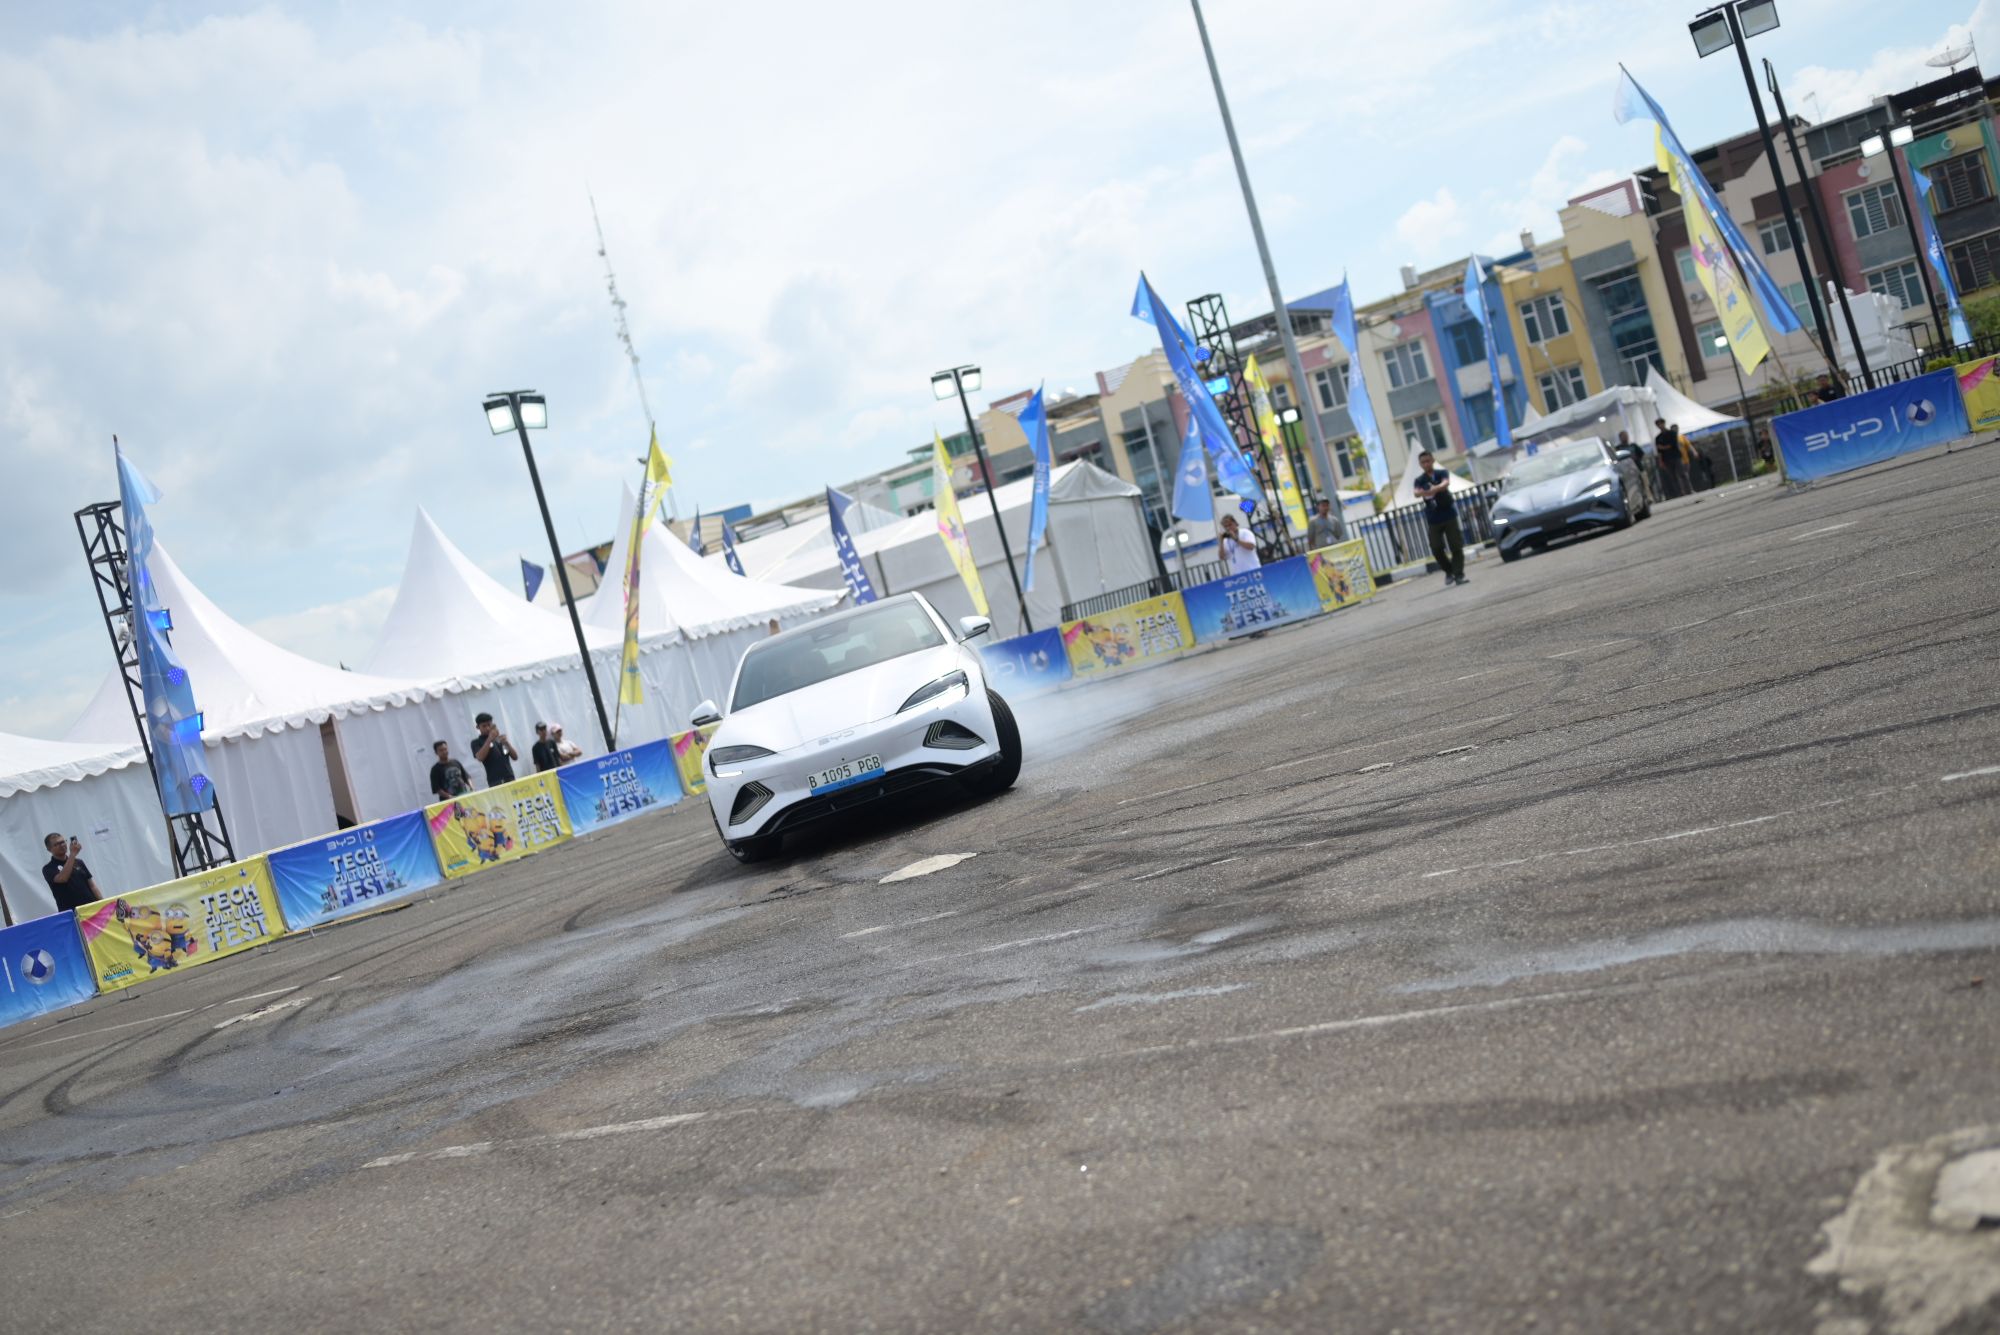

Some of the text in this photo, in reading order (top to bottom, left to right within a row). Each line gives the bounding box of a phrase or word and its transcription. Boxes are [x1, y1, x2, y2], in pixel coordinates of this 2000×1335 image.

[1803, 417, 1883, 452] BYD
[1225, 583, 1267, 603] TECH
[1136, 611, 1176, 631] TECH
[1230, 606, 1273, 629] FEST
[819, 730, 855, 746] BYD
[598, 757, 619, 769] BYD
[808, 775, 818, 789] B
[822, 764, 852, 784] 1095
[857, 756, 881, 774] PGB
[600, 768, 636, 788] TECH
[513, 793, 553, 816] TECH
[605, 792, 643, 817] FEST
[326, 836, 356, 851] BYD
[519, 820, 560, 848] FEST
[329, 845, 378, 872] TECH
[333, 860, 384, 886] CULTURE
[200, 882, 259, 915] TECH
[335, 876, 389, 906] FEST
[203, 900, 264, 928] CULTURE
[205, 915, 269, 952] FEST
